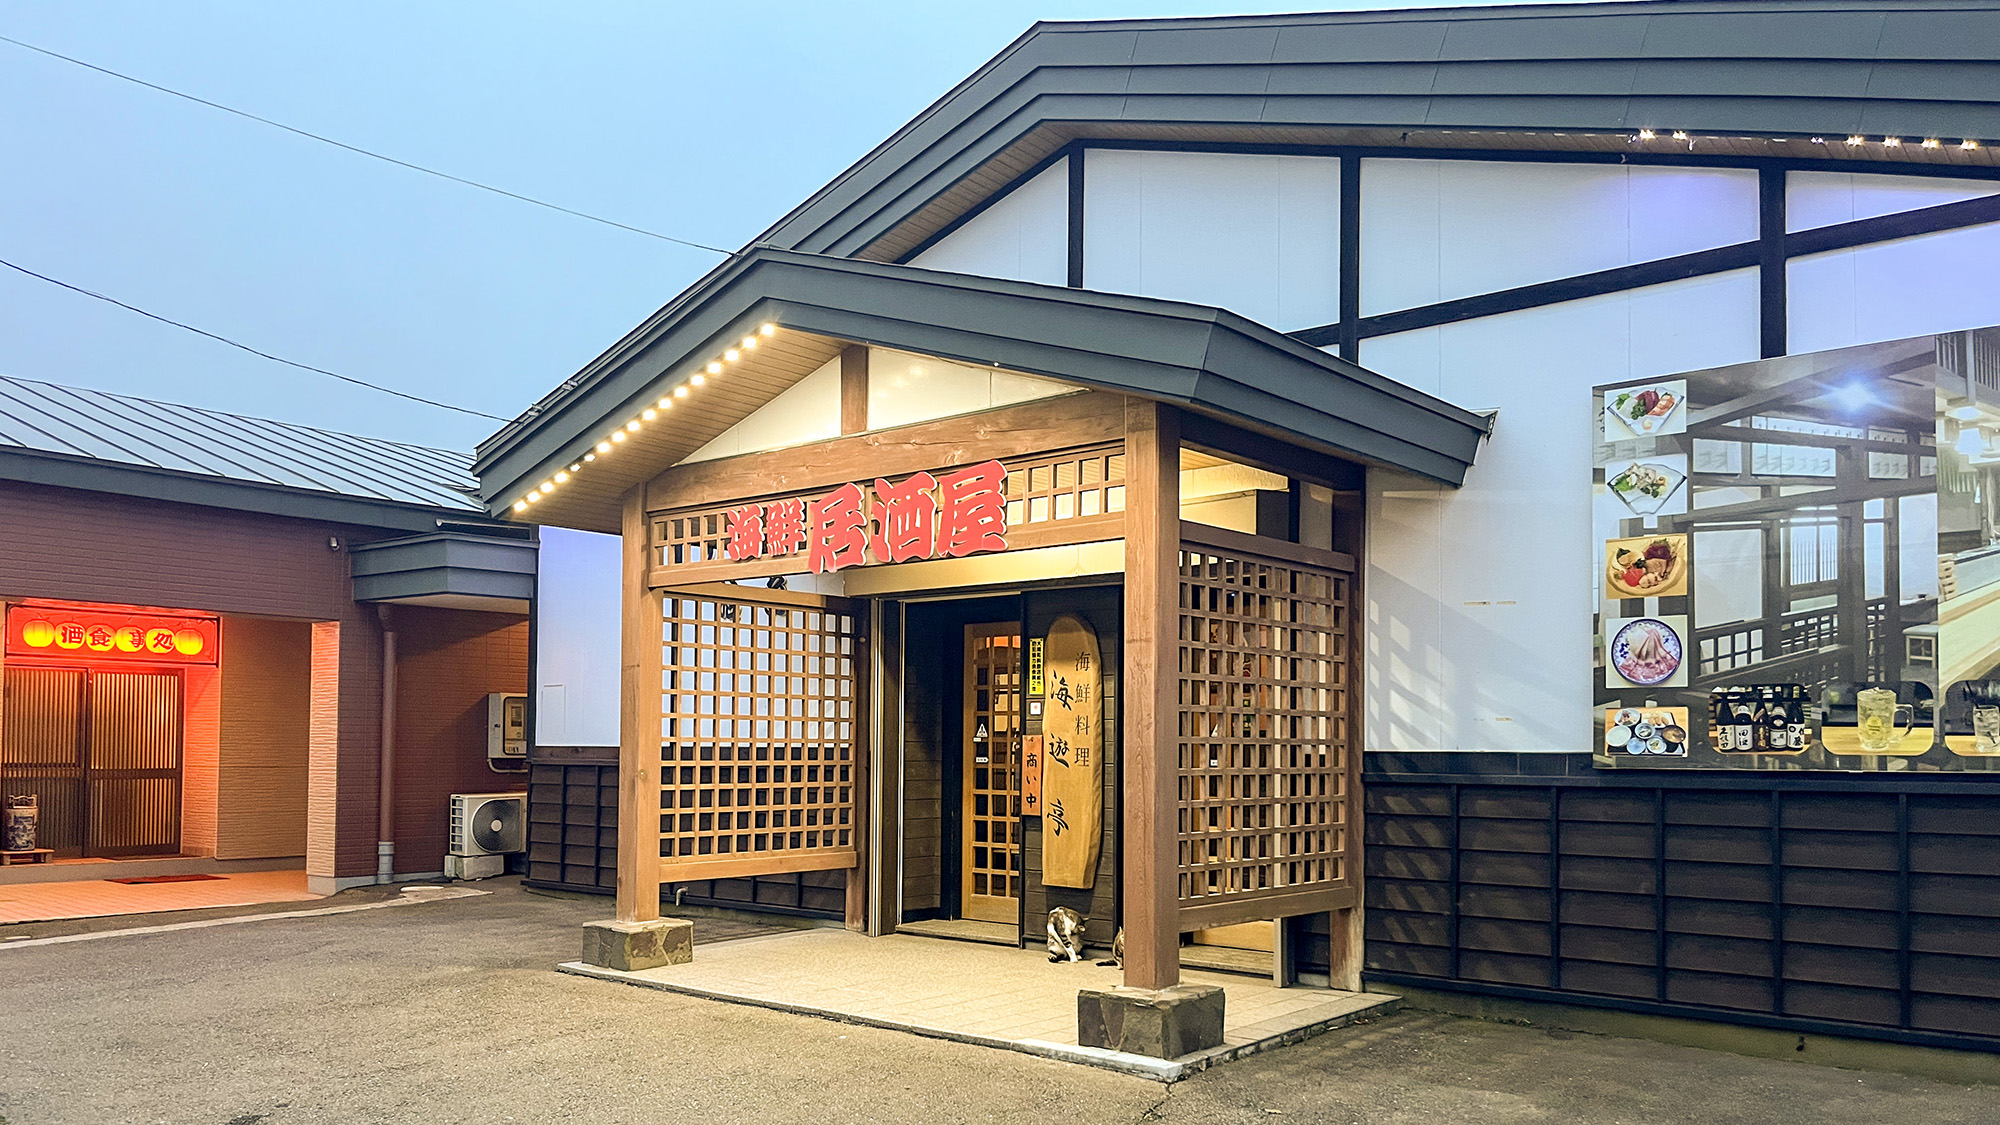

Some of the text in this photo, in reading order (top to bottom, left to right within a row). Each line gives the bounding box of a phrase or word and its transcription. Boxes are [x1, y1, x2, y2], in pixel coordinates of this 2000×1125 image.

[727, 459, 1008, 575] 海鮮居酒屋
[61, 624, 174, 650] 酒食事処
[1046, 669, 1075, 837] 海遊亭
[1074, 651, 1091, 768] 海鮮料理
[1026, 752, 1038, 809] 商い中
